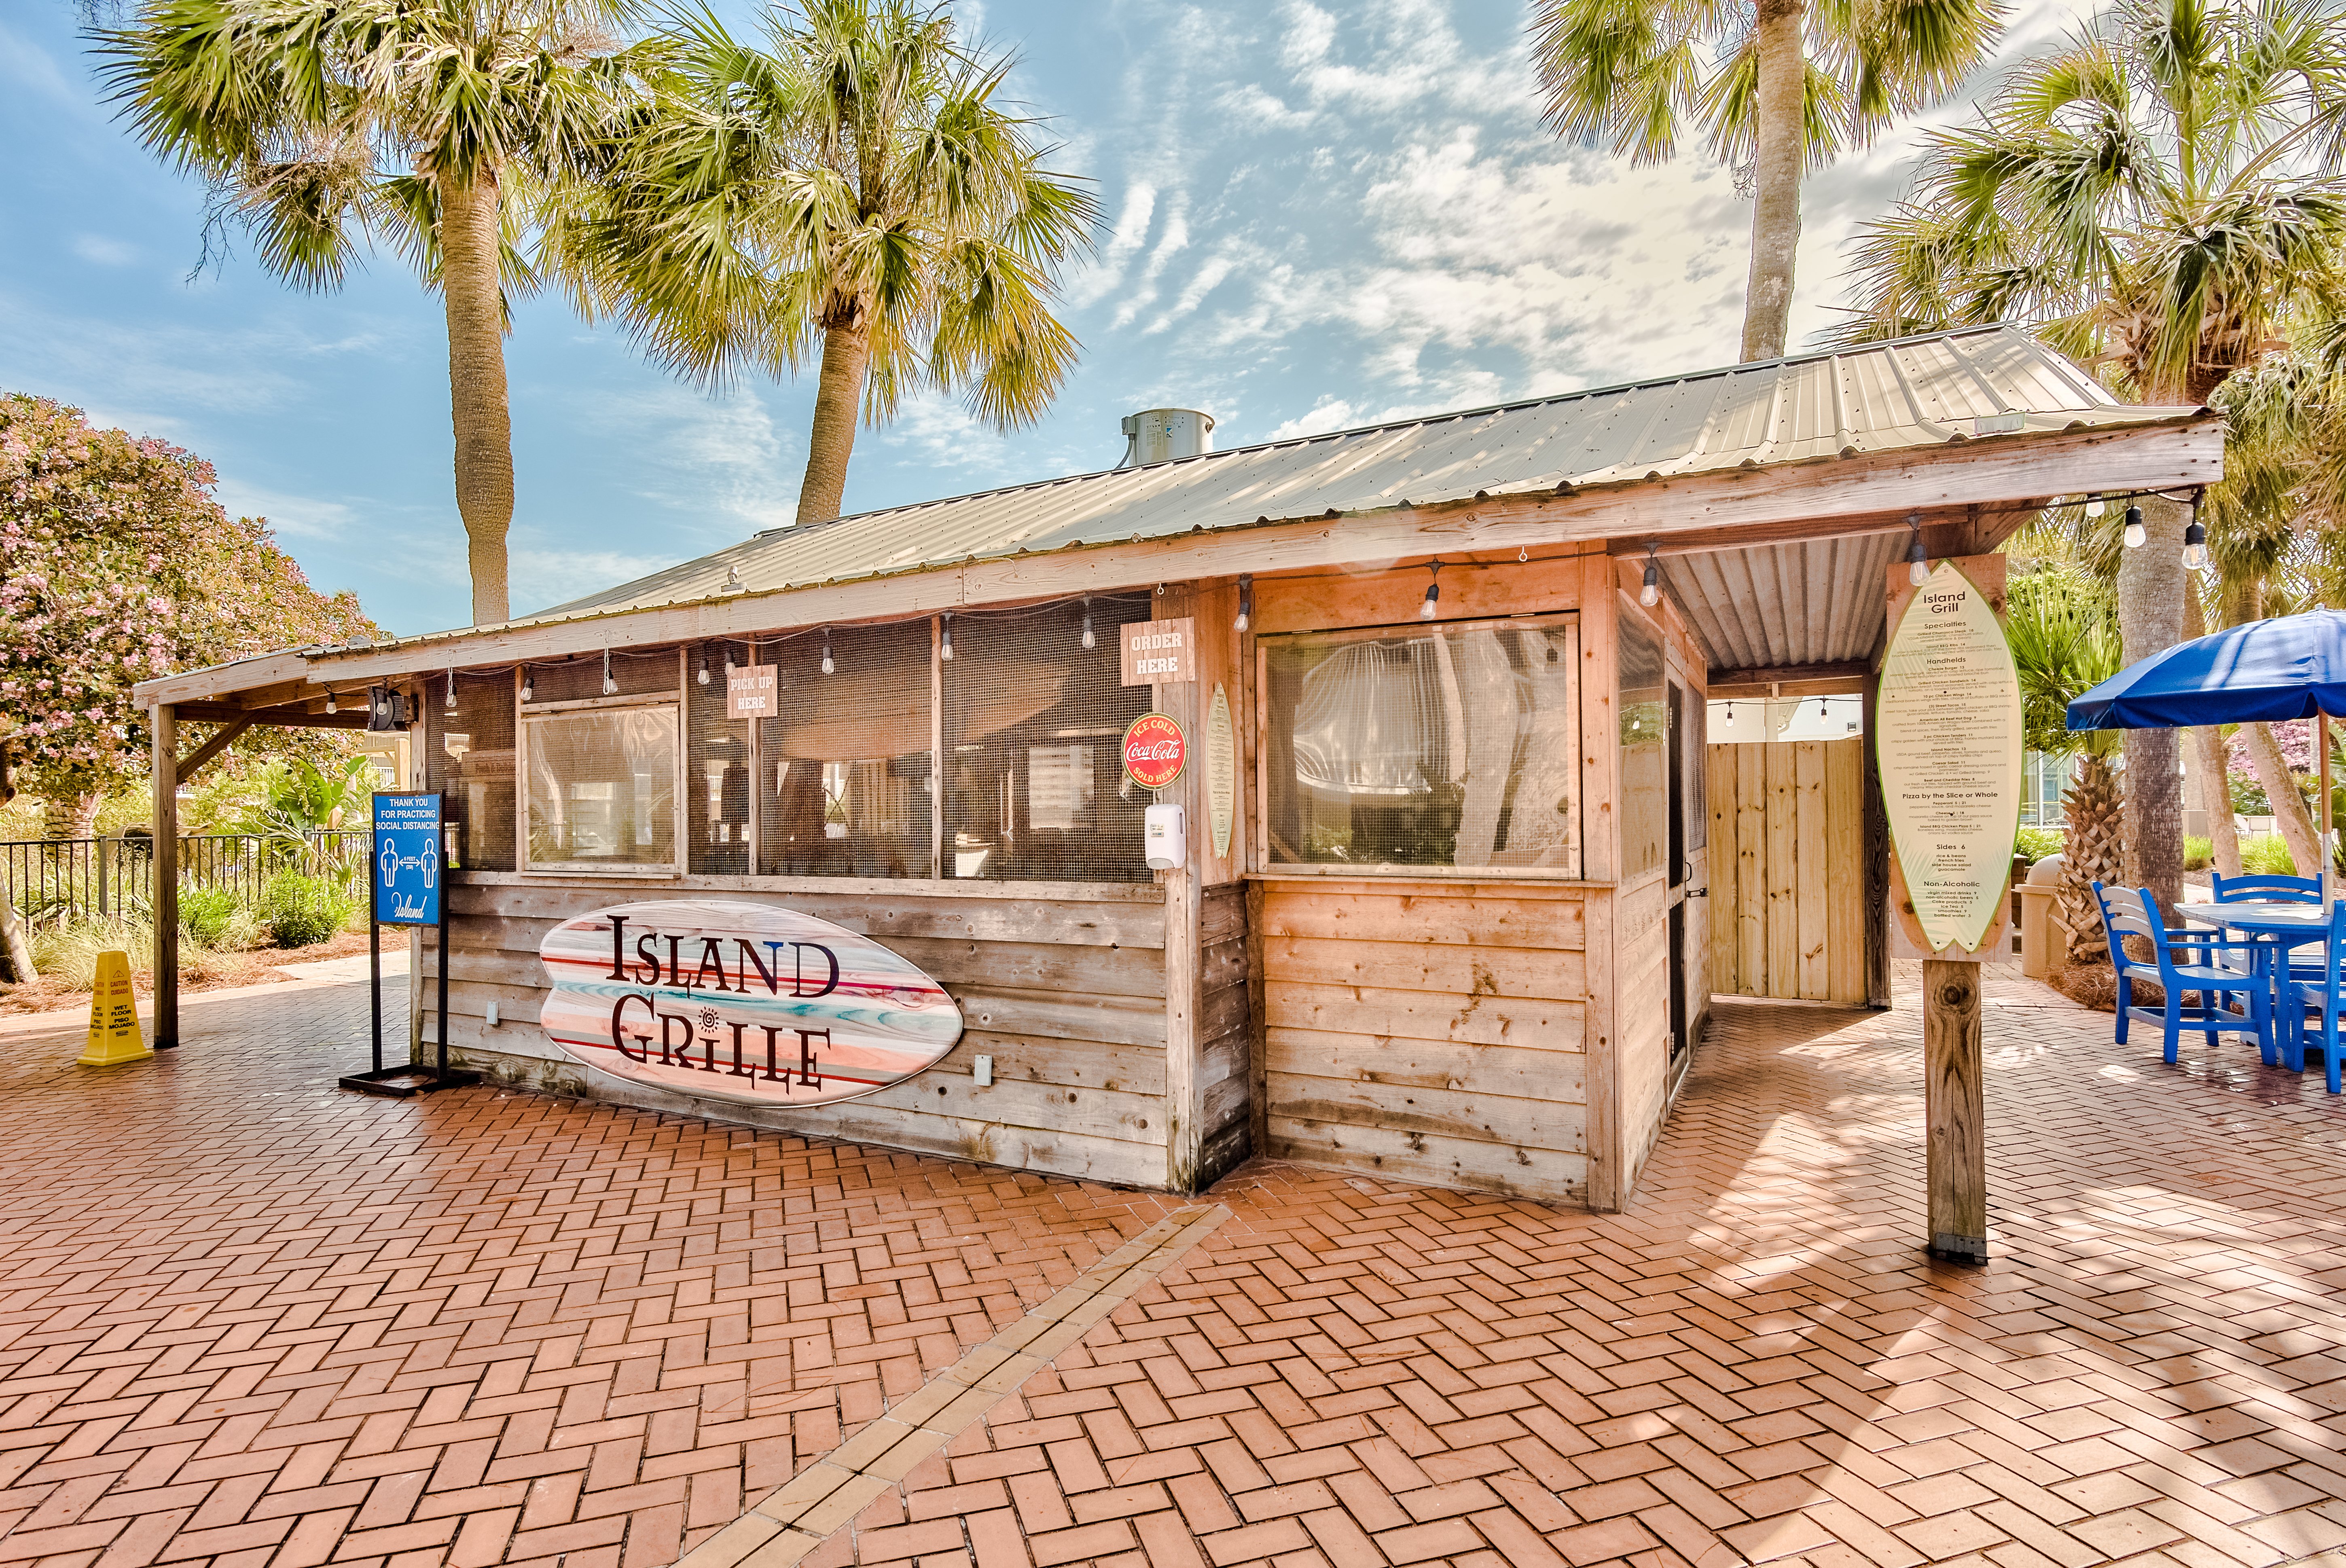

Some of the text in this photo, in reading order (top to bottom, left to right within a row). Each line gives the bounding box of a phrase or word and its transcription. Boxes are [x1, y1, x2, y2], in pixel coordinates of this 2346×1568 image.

[1923, 591, 1965, 603] Island
[1931, 603, 1959, 613] Grill
[1925, 621, 1966, 629] Specialties
[1131, 632, 1182, 652] ORDER
[1136, 656, 1178, 675] HERE
[730, 676, 773, 691] PICK UP
[738, 696, 766, 709] HERE
[1133, 720, 1175, 737] ICE COLD
[1126, 739, 1181, 762] Coca-Cola
[1133, 765, 1177, 782] SOLD HERE
[389, 798, 428, 806] THANK YOU
[381, 810, 436, 818] FOR PRACTICING
[403, 821, 439, 829] DISTANCING
[391, 892, 427, 919] Island
[606, 914, 840, 999] ISLAND
[612, 992, 831, 1095] GRILLE
